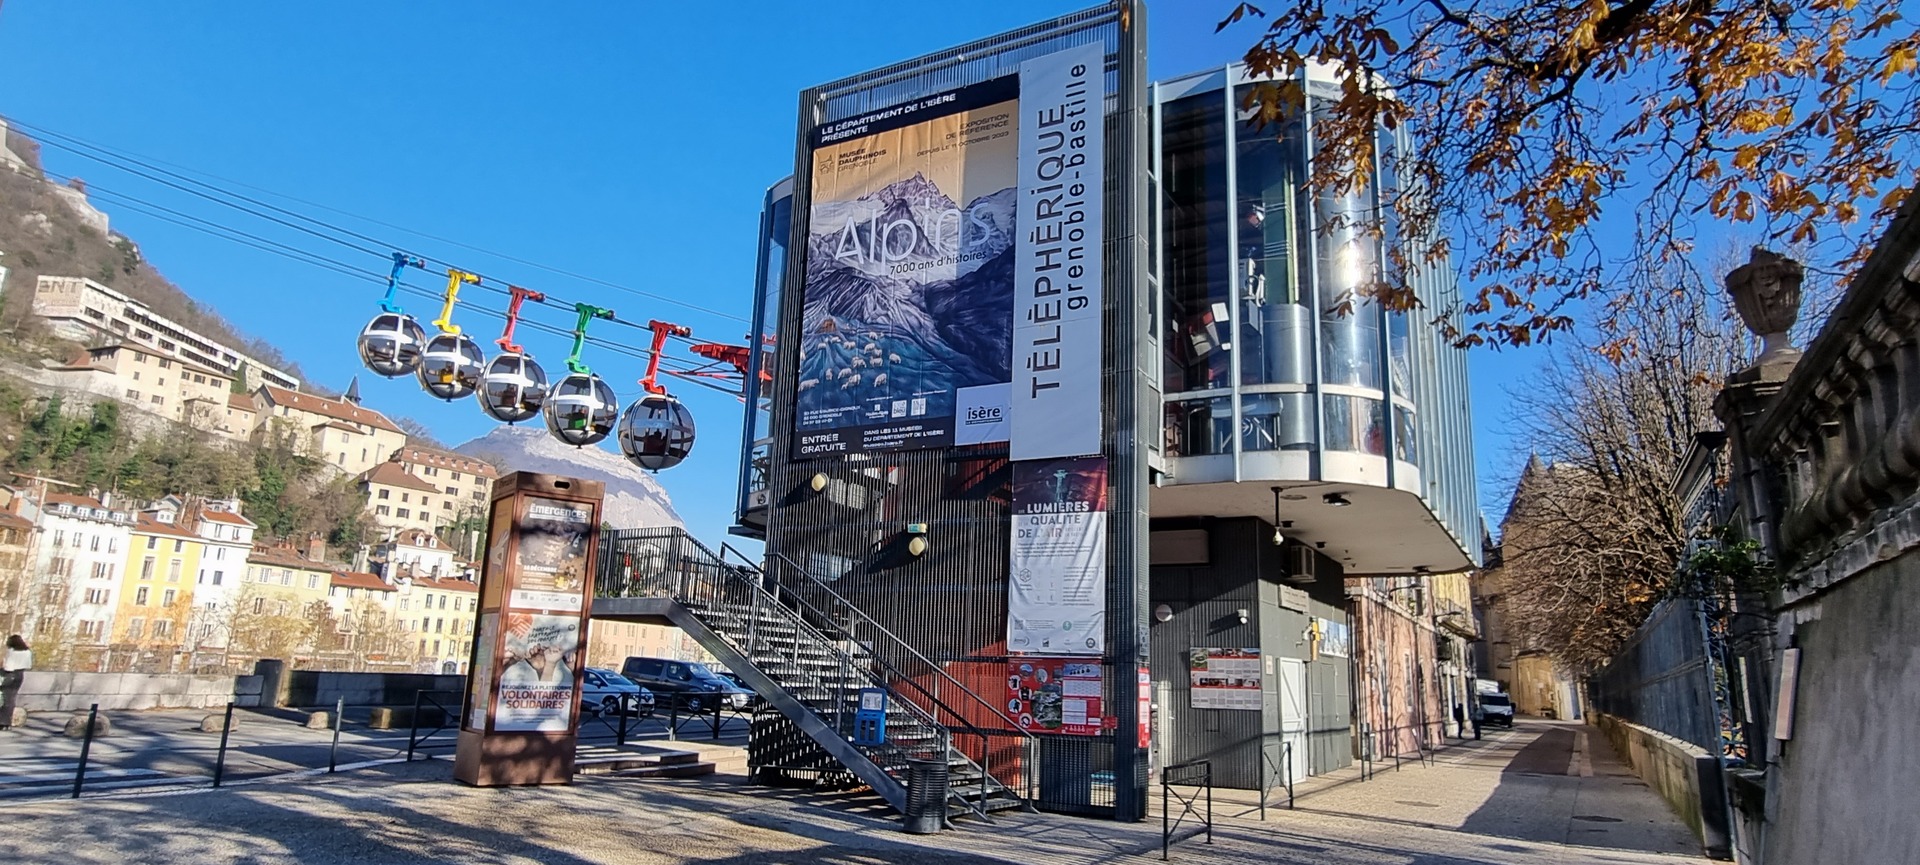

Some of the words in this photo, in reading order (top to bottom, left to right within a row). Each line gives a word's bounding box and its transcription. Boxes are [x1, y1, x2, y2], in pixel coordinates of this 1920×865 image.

[821, 126, 834, 135] LE
[835, 107, 904, 131] DÉPARTEMENT
[904, 104, 918, 114] DE
[920, 93, 956, 109] L'ISÈRE
[960, 113, 1010, 129] EXPOSITION
[821, 125, 868, 143] PRÉSENTE
[959, 120, 1009, 136] RÉFÉRENCE
[839, 148, 866, 159] MUSÉE
[916, 147, 940, 157] DEPUIS
[958, 135, 991, 147] OCTOBRE
[838, 149, 887, 166] DAUPHINOIS
[838, 158, 877, 172] GRENOBLE
[1064, 63, 1089, 311] grenoble-bastille
[834, 197, 991, 277] Alpins
[889, 262, 916, 275] 7000
[917, 260, 934, 270] ans
[936, 250, 987, 267] d'histoires
[967, 405, 1001, 420] isère
[802, 433, 839, 445] ENTRÉE
[801, 442, 847, 454] GRATUITE
[1027, 500, 1090, 514] LUMIÈRES
[1017, 528, 1032, 539] DE
[501, 690, 571, 700] VOLONTAIRES
[506, 700, 565, 710] SOLIDAIRES
